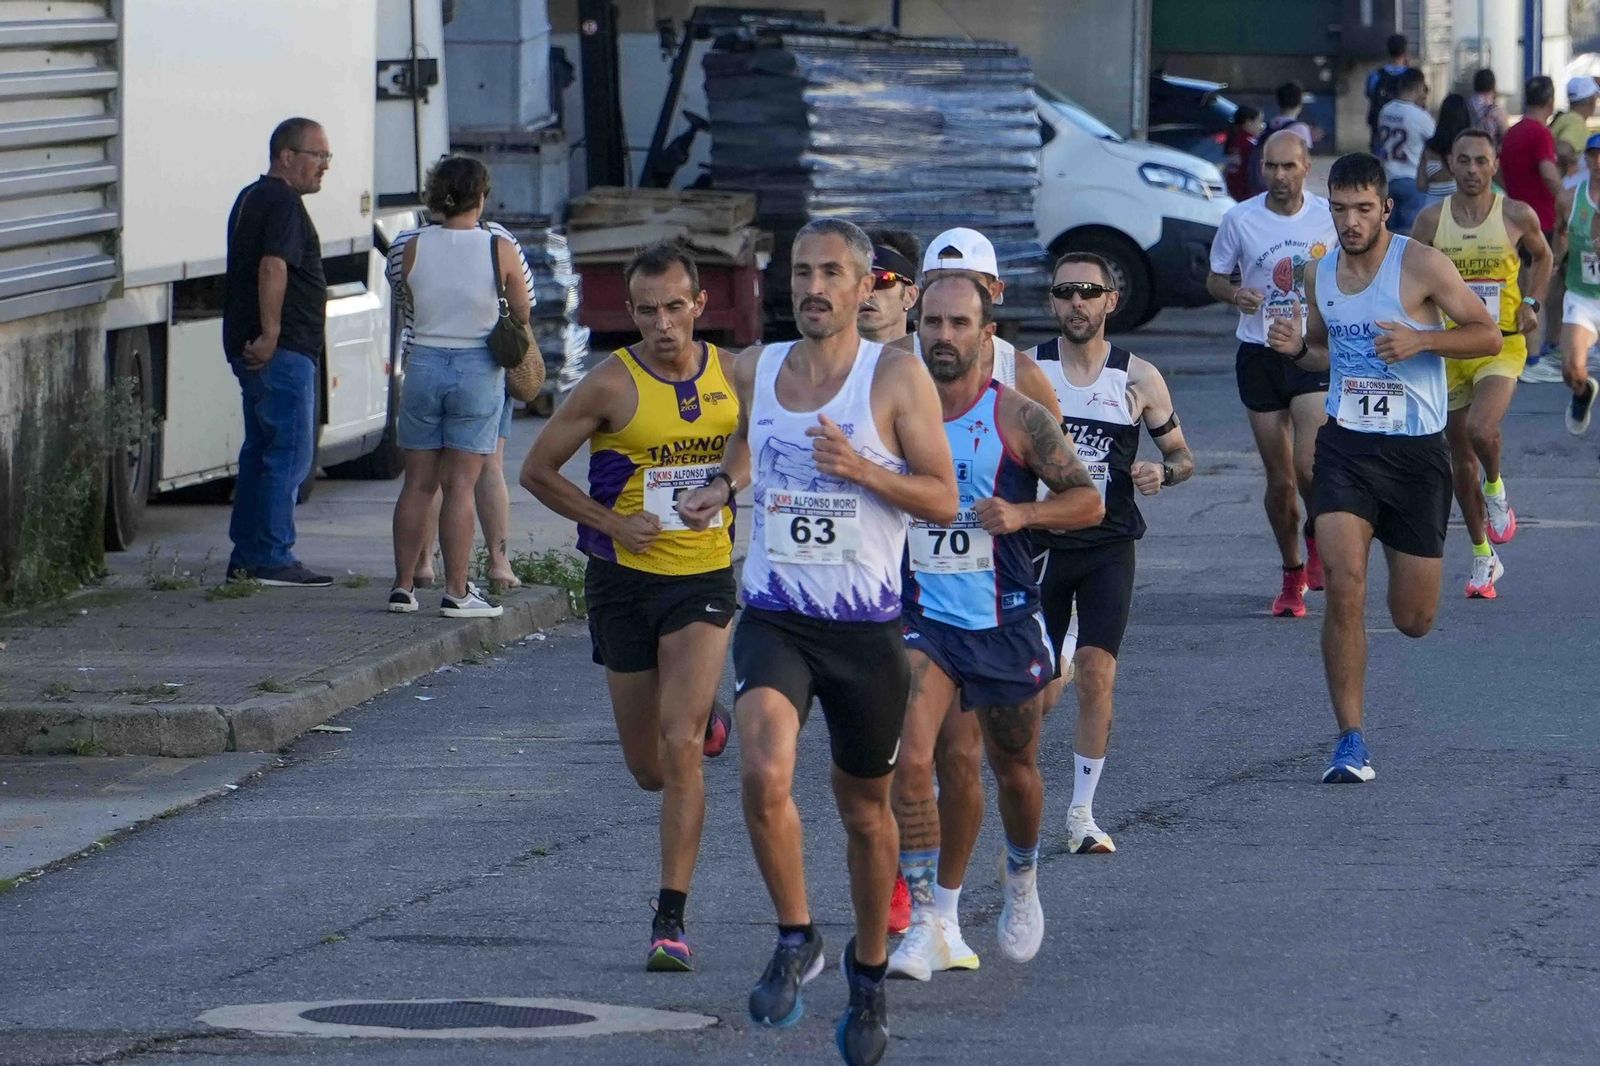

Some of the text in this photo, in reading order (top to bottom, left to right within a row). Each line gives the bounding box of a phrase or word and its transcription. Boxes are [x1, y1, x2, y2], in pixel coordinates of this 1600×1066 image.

[1270, 243, 1282, 254] por
[1284, 239, 1309, 248] Mauri
[1359, 381, 1386, 390] ALFONSO
[1387, 382, 1404, 391] MORO
[680, 404, 698, 412] ZICO
[1358, 395, 1390, 416] 14
[1066, 422, 1114, 452] ikia
[1077, 447, 1098, 458] fresh
[648, 471, 672, 481] 10KMS
[674, 468, 704, 480] ALFONSO
[1087, 464, 1107, 473] MORO
[769, 493, 857, 509] 10KMS ALFONSO MORO
[790, 516, 836, 545] 63
[928, 529, 970, 556] 70
